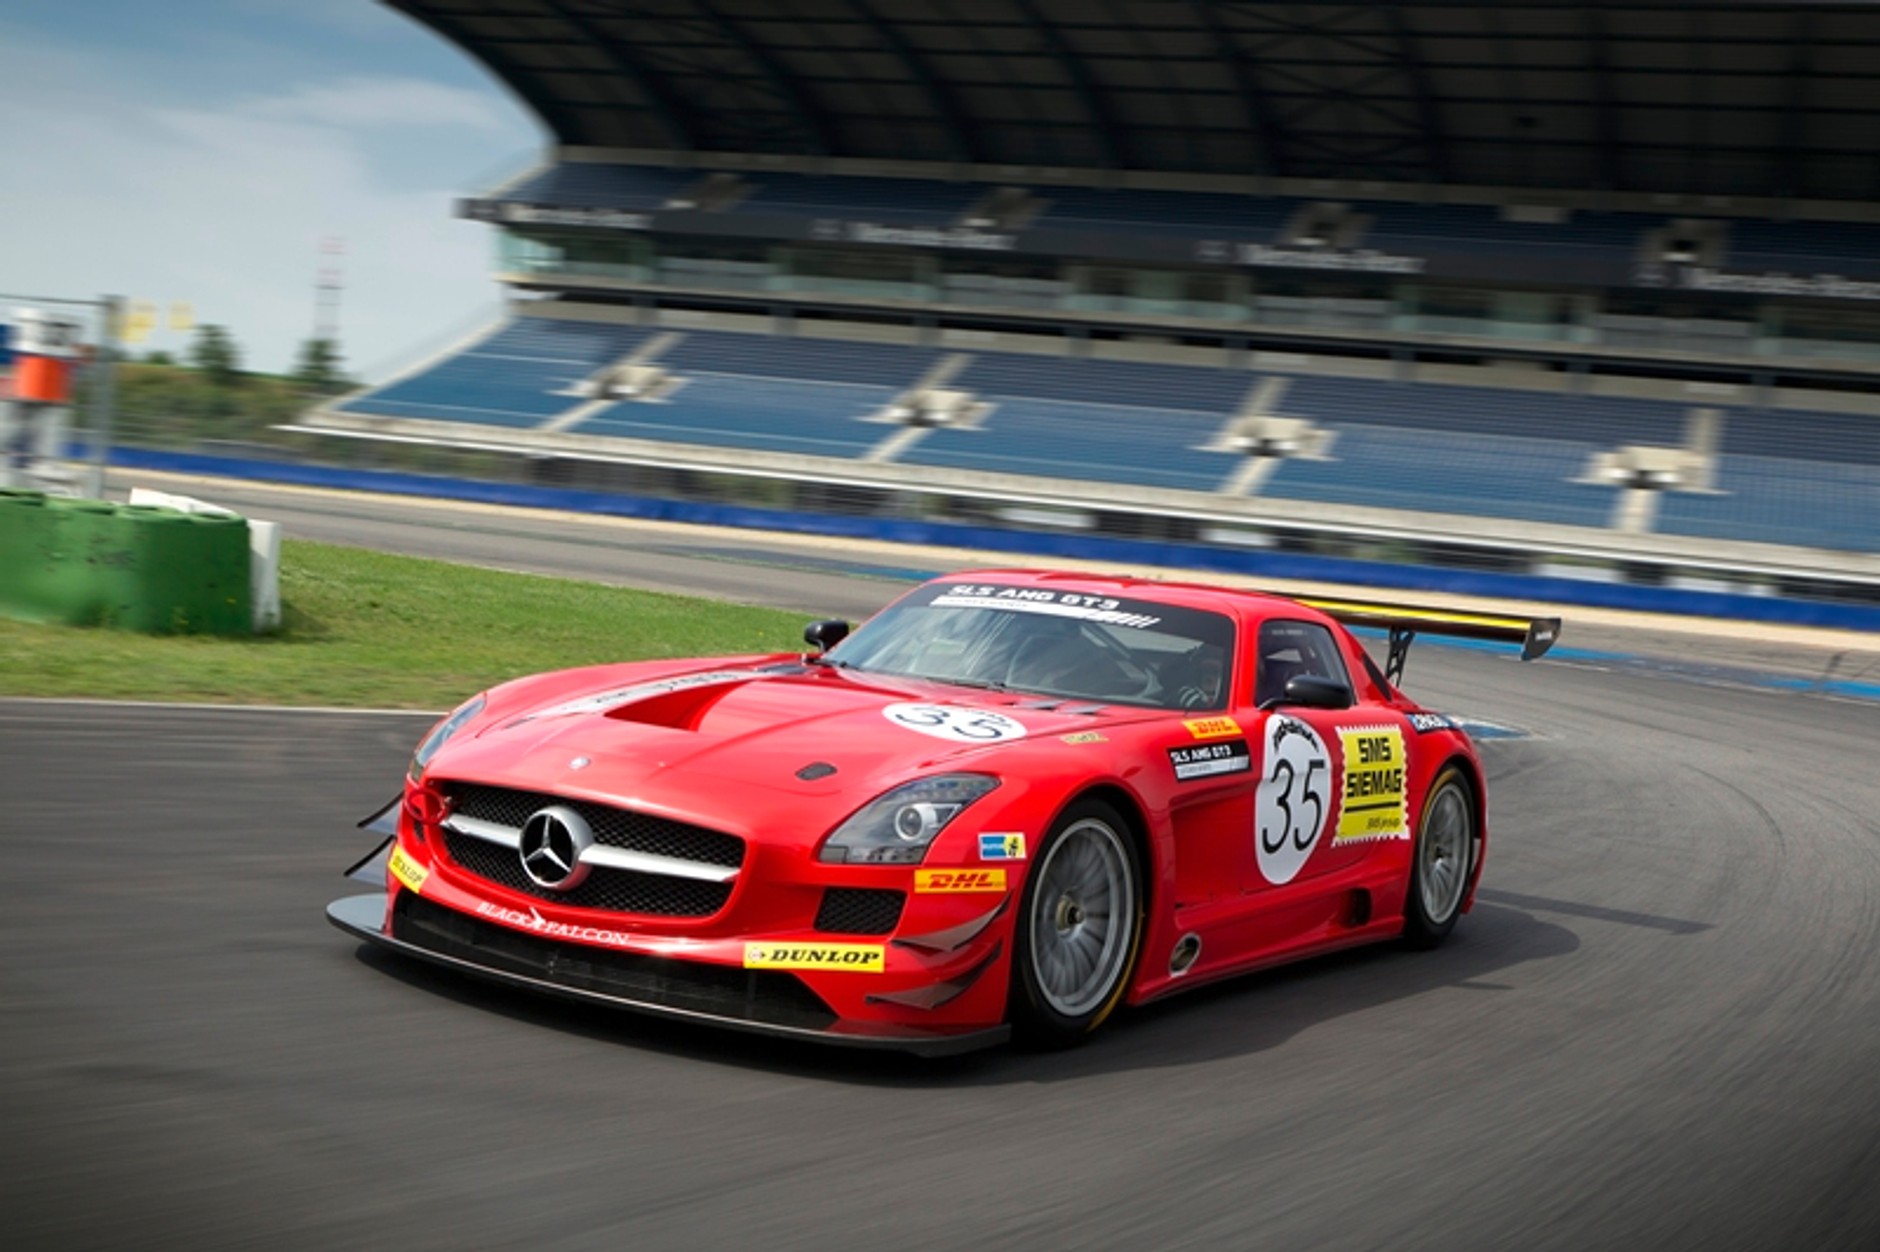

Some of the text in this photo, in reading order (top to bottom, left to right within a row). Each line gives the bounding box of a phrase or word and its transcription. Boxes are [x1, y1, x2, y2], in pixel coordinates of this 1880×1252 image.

[948, 584, 1121, 611] SLS AMG GT3
[894, 706, 1012, 739] 35
[1194, 720, 1233, 735] DHL
[1170, 750, 1191, 764] SLS
[1190, 746, 1212, 761] AMG
[1357, 737, 1393, 764] SMS
[1346, 768, 1402, 798] SIEMAG
[1262, 758, 1326, 855] 35
[929, 873, 993, 889] DHL
[476, 901, 630, 945] BLACK FALCON
[769, 949, 881, 964] DUNLOP
